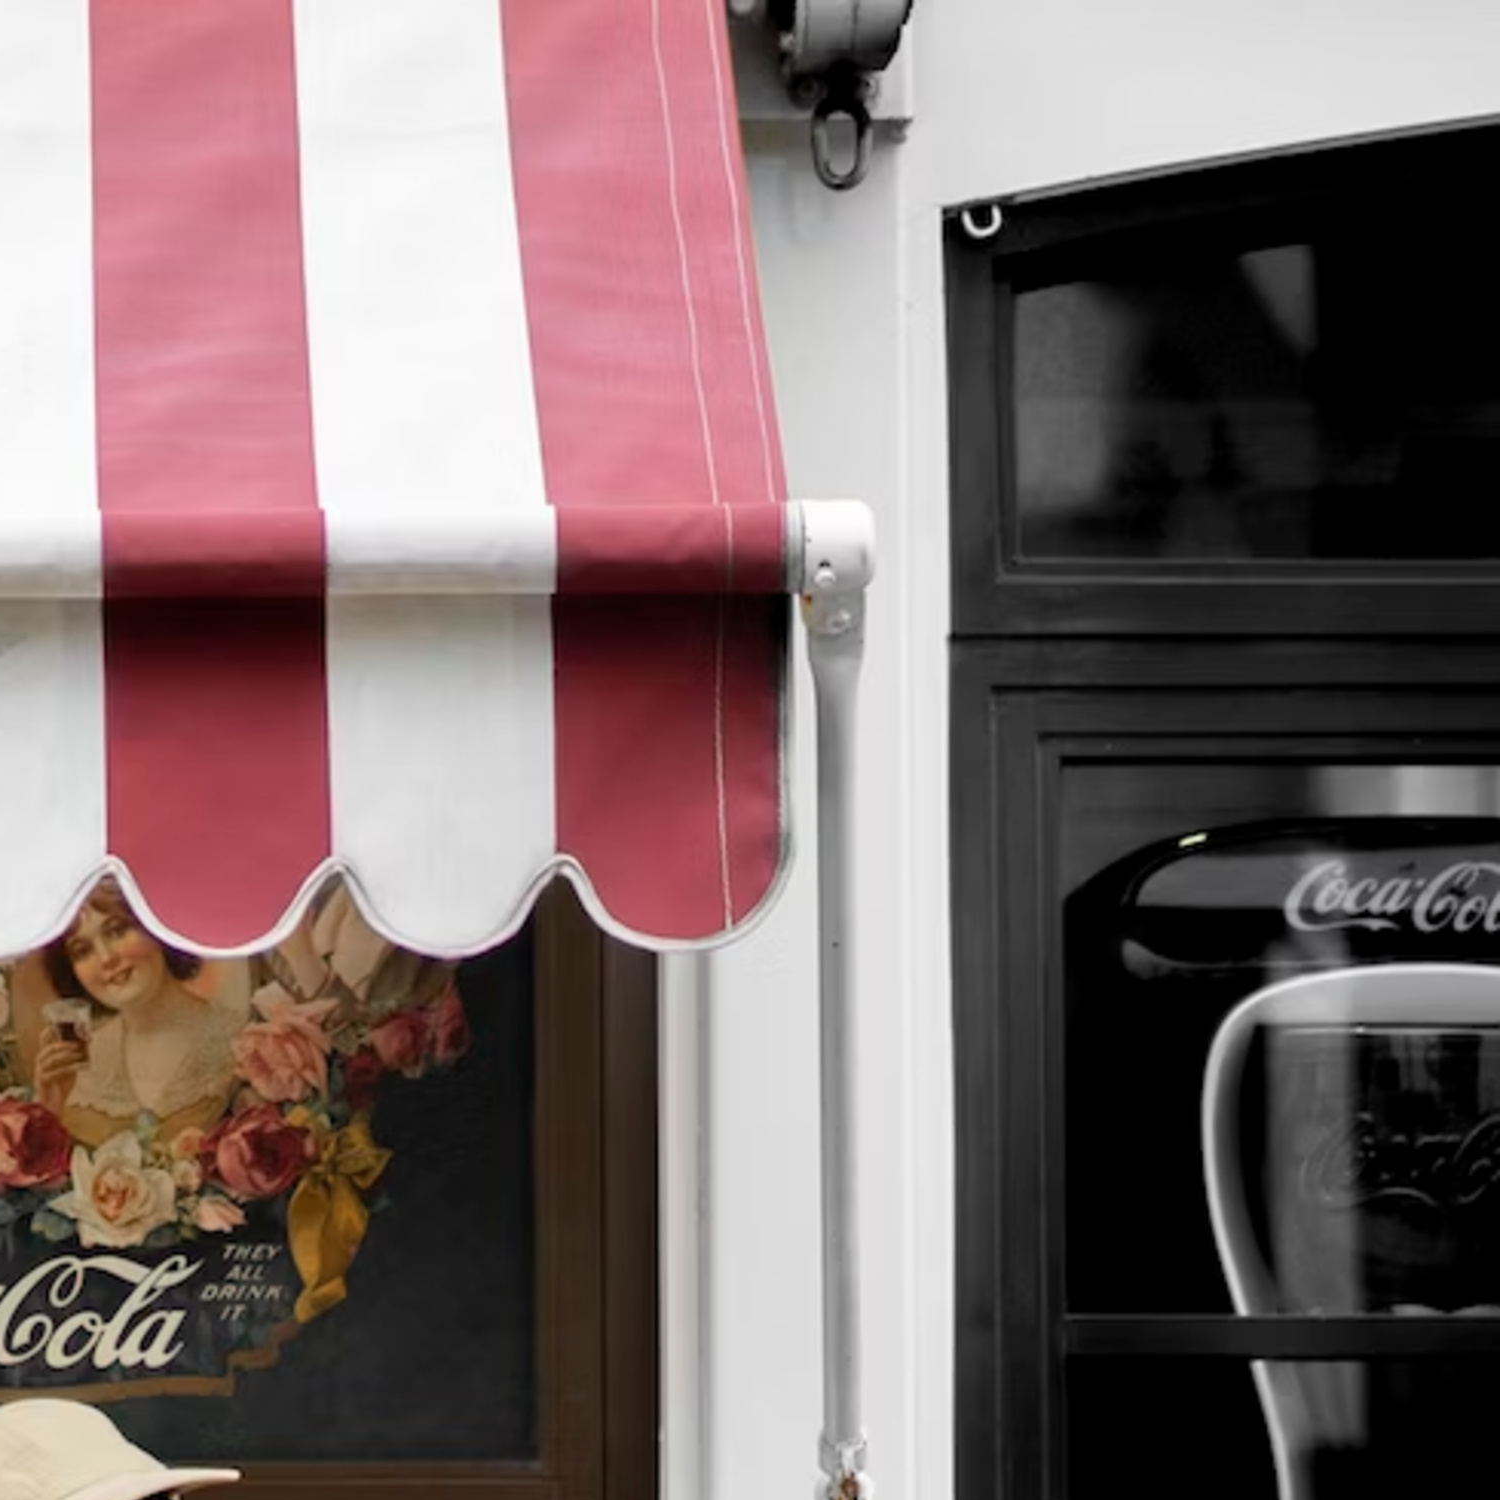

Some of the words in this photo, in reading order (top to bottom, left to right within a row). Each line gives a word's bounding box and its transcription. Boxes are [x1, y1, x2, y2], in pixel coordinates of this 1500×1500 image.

[222, 1244, 282, 1260] THEY
[225, 1264, 264, 1280] ALL
[201, 1283, 284, 1300] DRINK
